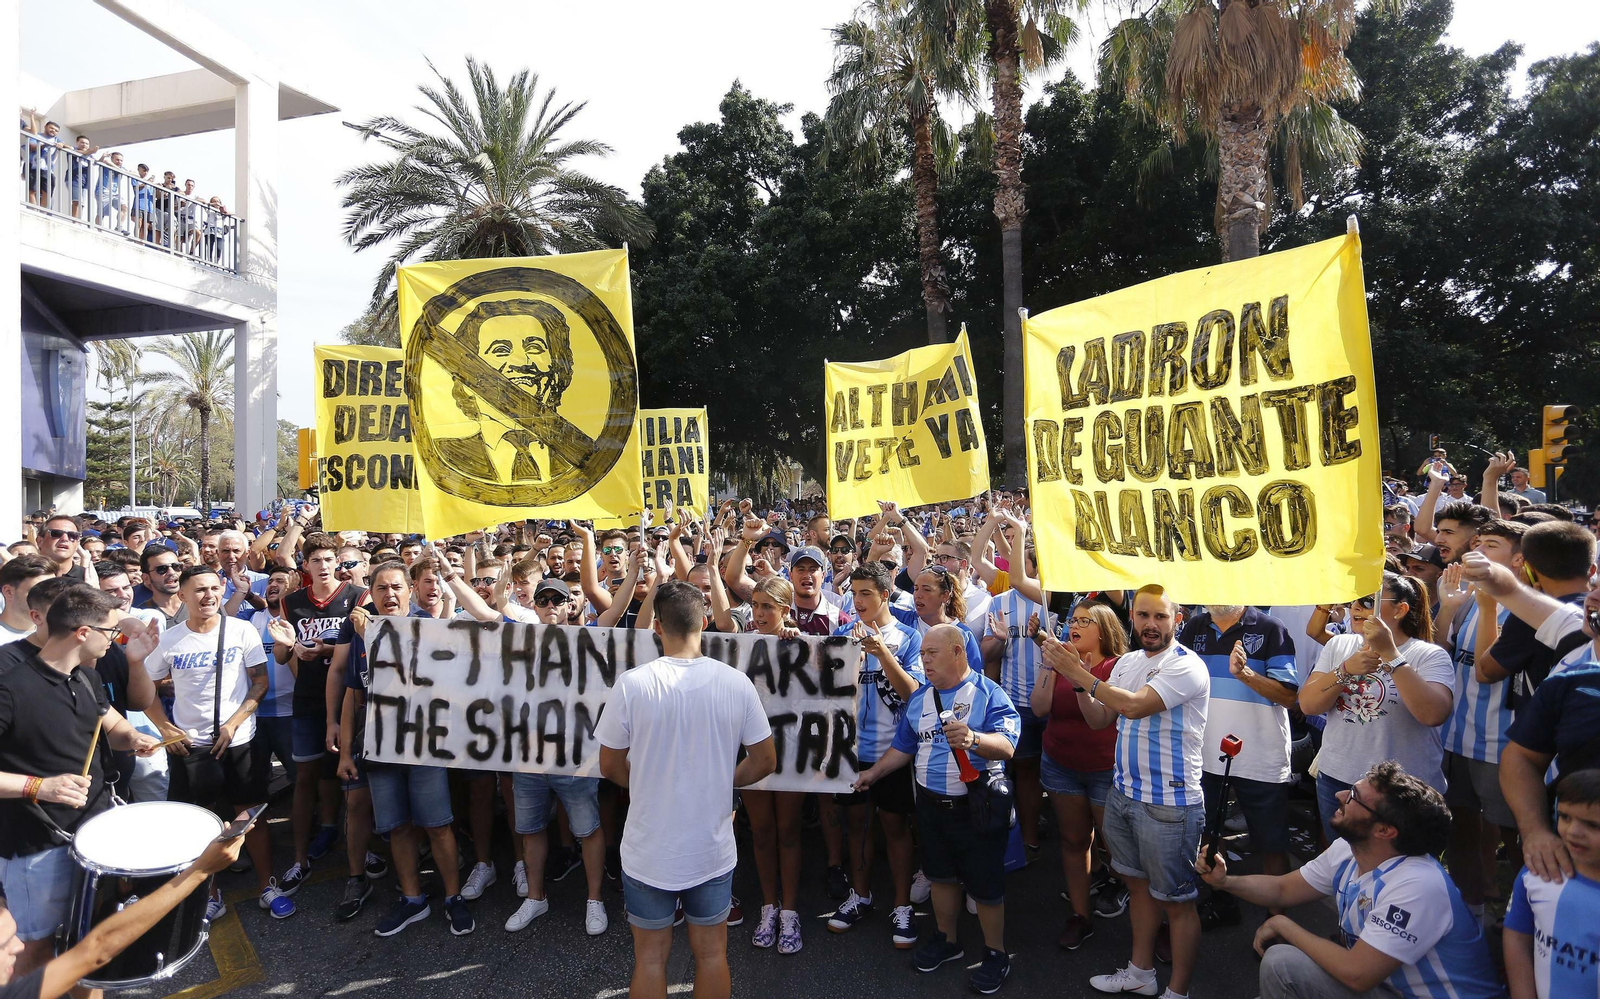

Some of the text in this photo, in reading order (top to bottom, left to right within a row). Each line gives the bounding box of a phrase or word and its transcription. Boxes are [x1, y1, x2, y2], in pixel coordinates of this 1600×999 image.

[1056, 293, 1295, 412] LADRON
[323, 359, 410, 399] DIRE
[640, 416, 701, 446] ILIA
[835, 407, 979, 483] VETE YA
[1033, 374, 1362, 485] DE GUANTE
[318, 453, 419, 494] ESCON
[643, 477, 693, 510] ERA
[1070, 478, 1318, 562] BLANCO
[173, 650, 212, 670] NIKE
[746, 635, 857, 698] ARE
[366, 693, 456, 761] THE
[738, 709, 860, 780] TAR
[1370, 914, 1418, 944] BESOCCER
